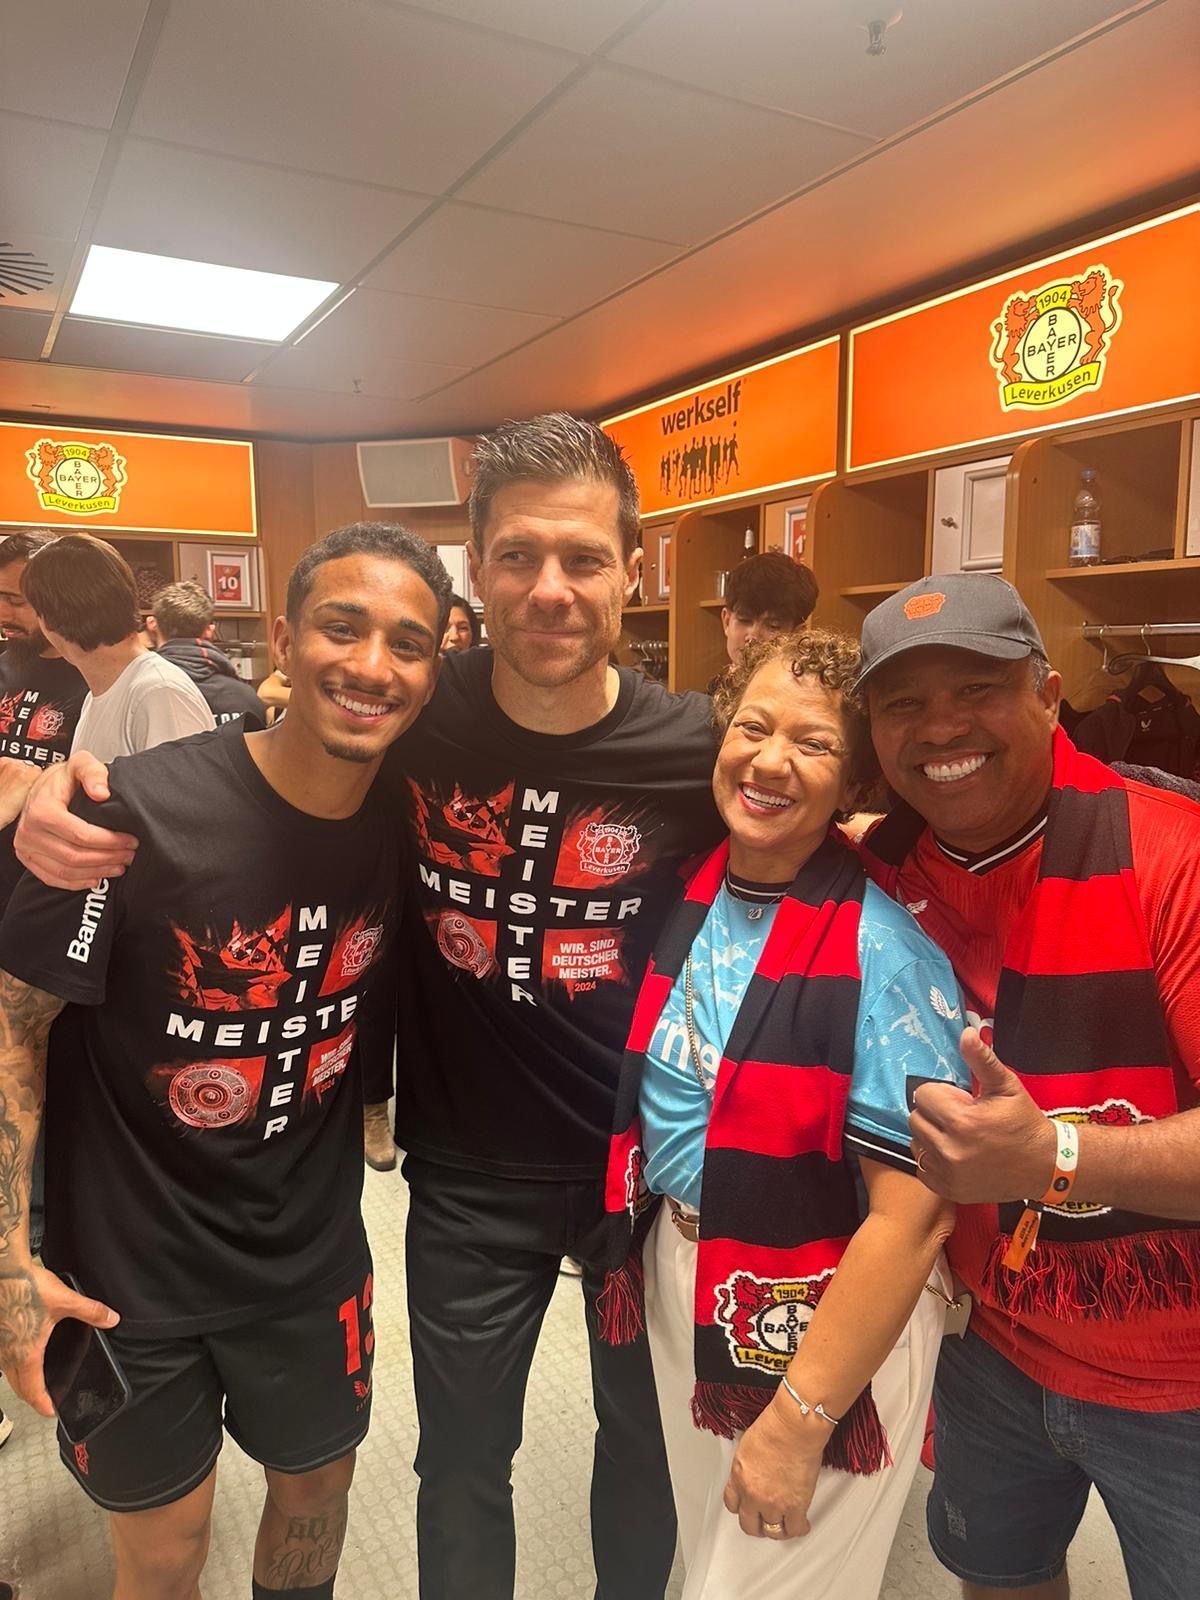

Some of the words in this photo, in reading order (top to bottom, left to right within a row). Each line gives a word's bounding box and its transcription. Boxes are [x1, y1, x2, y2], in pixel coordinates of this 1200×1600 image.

[1039, 289, 1068, 309] 1904
[1027, 333, 1078, 358] BAYER
[1046, 314, 1058, 377] BAYER
[1011, 370, 1091, 401] Leverkusen
[661, 380, 741, 436] werkself
[65, 447, 87, 457] 1904
[59, 474, 98, 484] BAYER
[74, 461, 83, 497] BAYER
[48, 495, 111, 510] Leverkusen
[218, 576, 238, 590] 10
[583, 862, 626, 874] Leverkusen
[418, 863, 643, 921] MEISTER
[507, 788, 560, 1007] MEISTER
[560, 943, 588, 954] WIR.
[590, 939, 616, 952] SIND
[552, 949, 619, 967] DEUTSCHER
[559, 964, 612, 979] MEISTER.
[574, 981, 597, 992] 2024
[166, 989, 367, 1048] MEISTE
[263, 905, 328, 1141] MEISTER
[776, 1289, 805, 1299] 1904
[764, 1320, 809, 1334] BAYE
[745, 1350, 793, 1369] Lever
